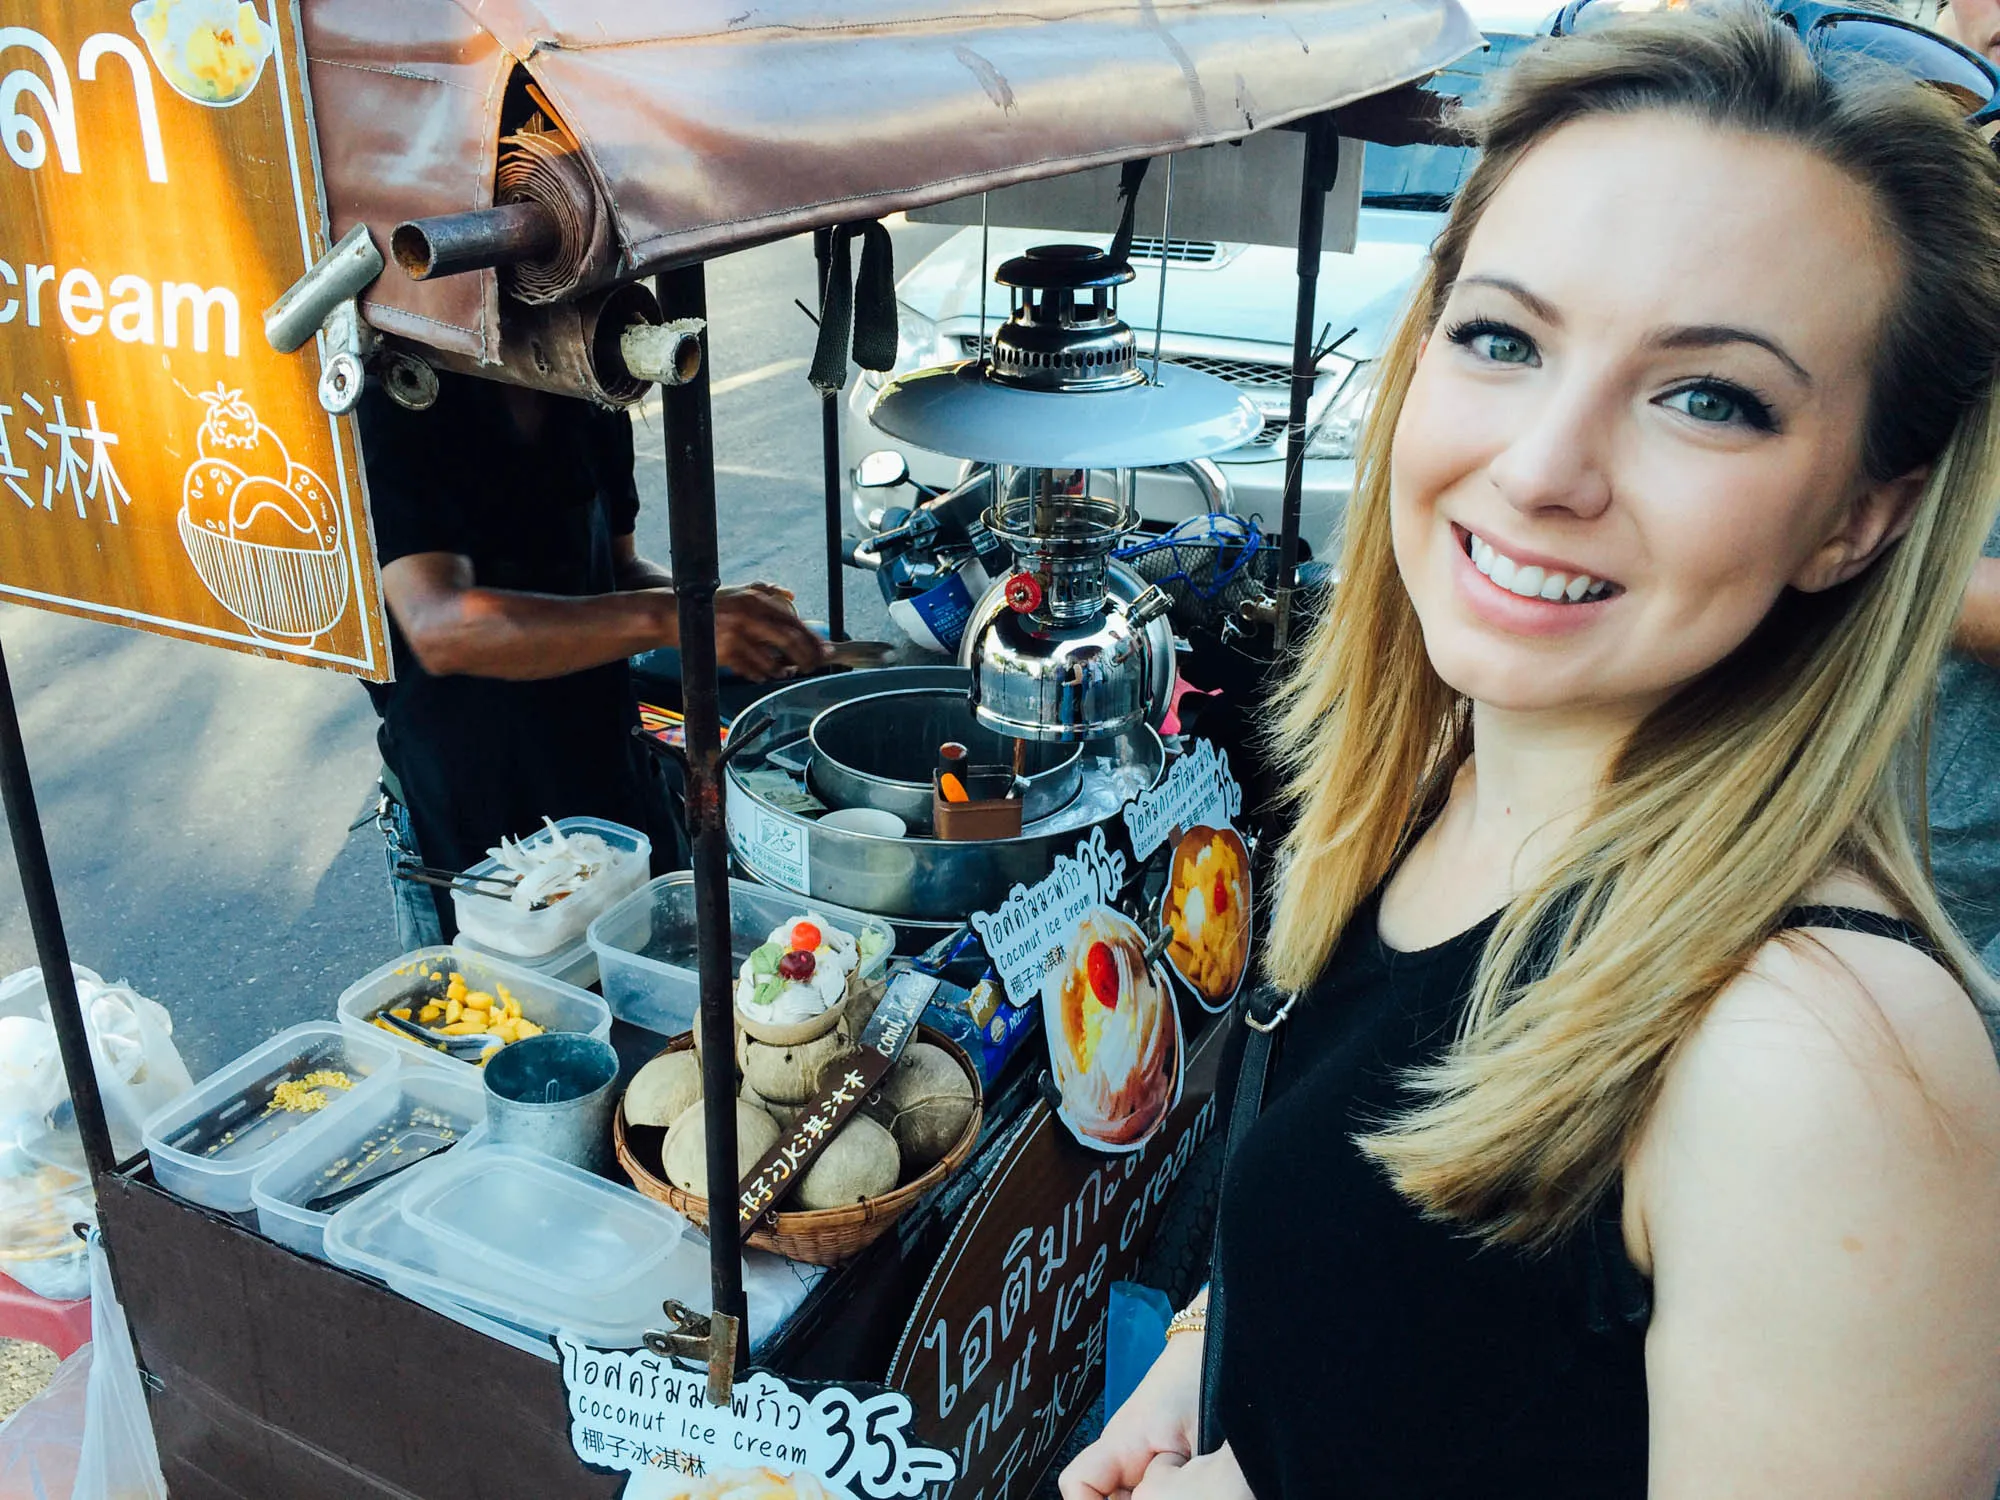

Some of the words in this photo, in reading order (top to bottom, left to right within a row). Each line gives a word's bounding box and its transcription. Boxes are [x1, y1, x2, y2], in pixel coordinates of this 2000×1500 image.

[564, 1341, 801, 1431] ไอศครีมมพร้าว
[581, 1426, 708, 1479] 椰子冰淇淋
[733, 1430, 808, 1466] cream
